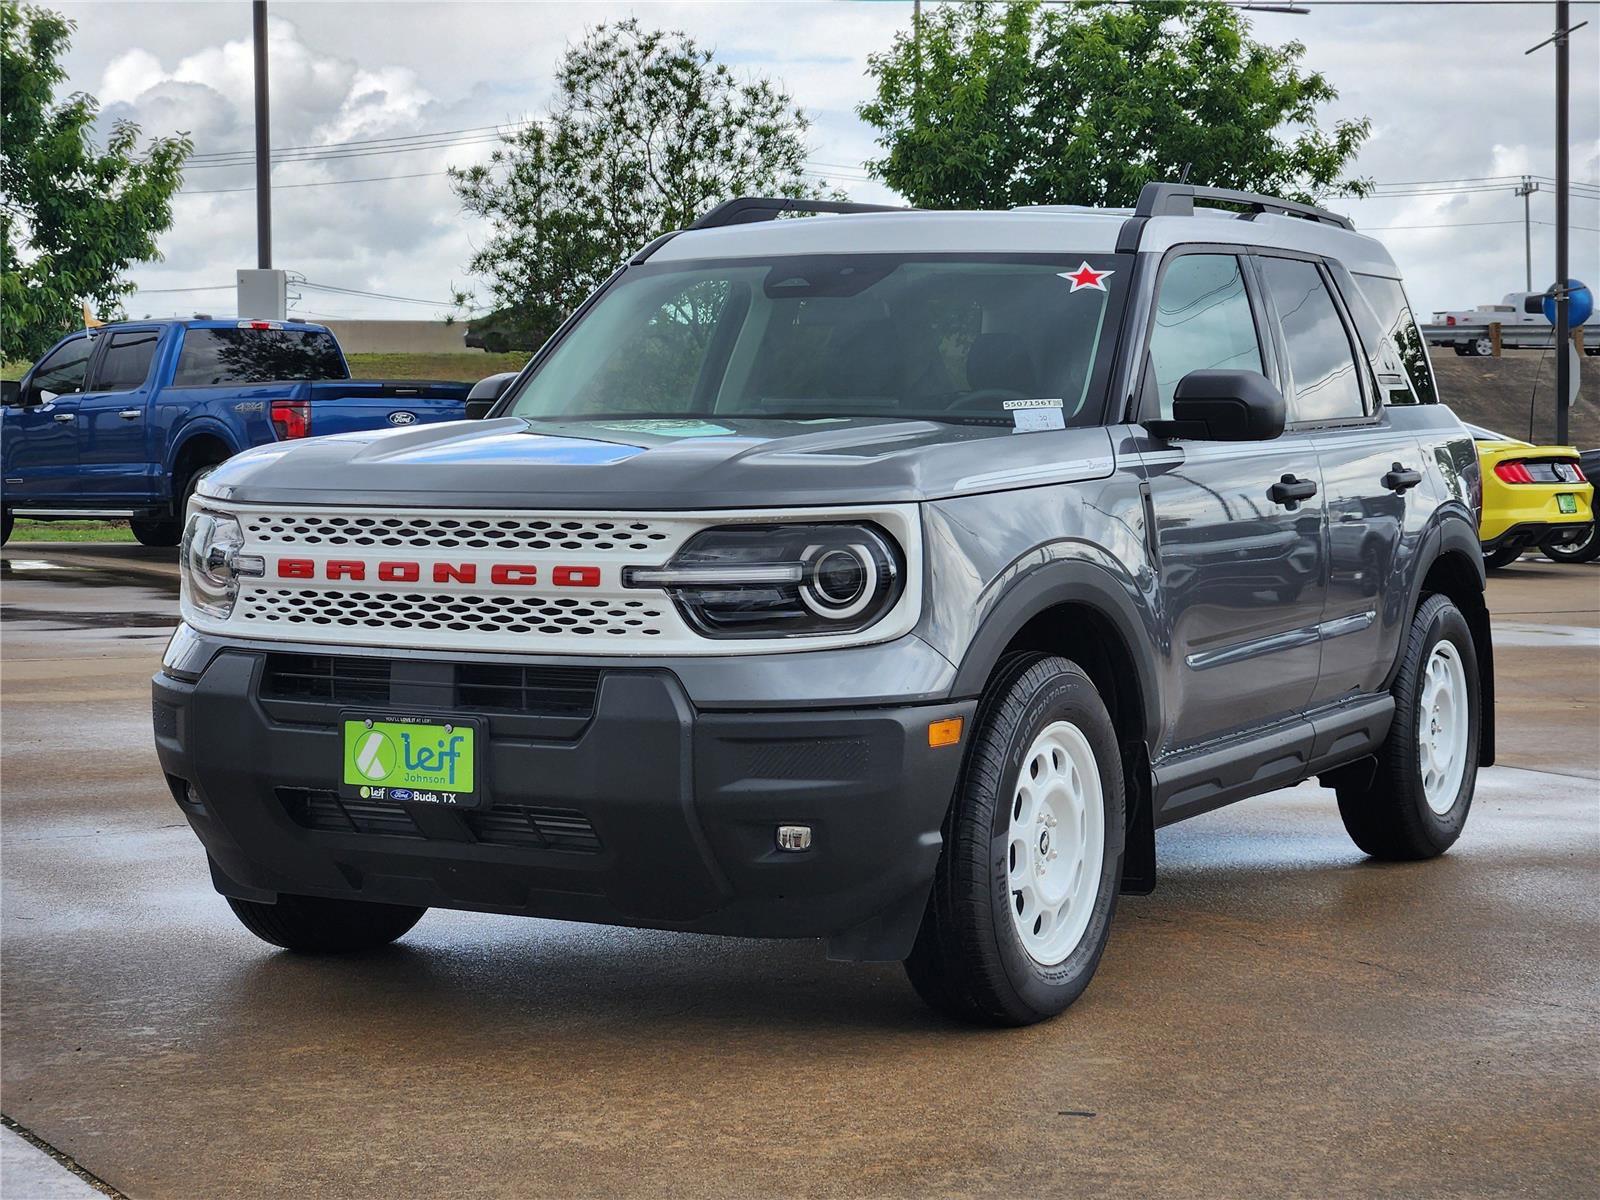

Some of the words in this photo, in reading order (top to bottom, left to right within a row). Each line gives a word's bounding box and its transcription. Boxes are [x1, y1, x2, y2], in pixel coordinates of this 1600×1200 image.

[278, 558, 601, 587] BRONCO
[401, 733, 464, 785] leif
[404, 773, 446, 784] Johnson
[413, 791, 440, 803] Buda,
[442, 793, 457, 804] TX
